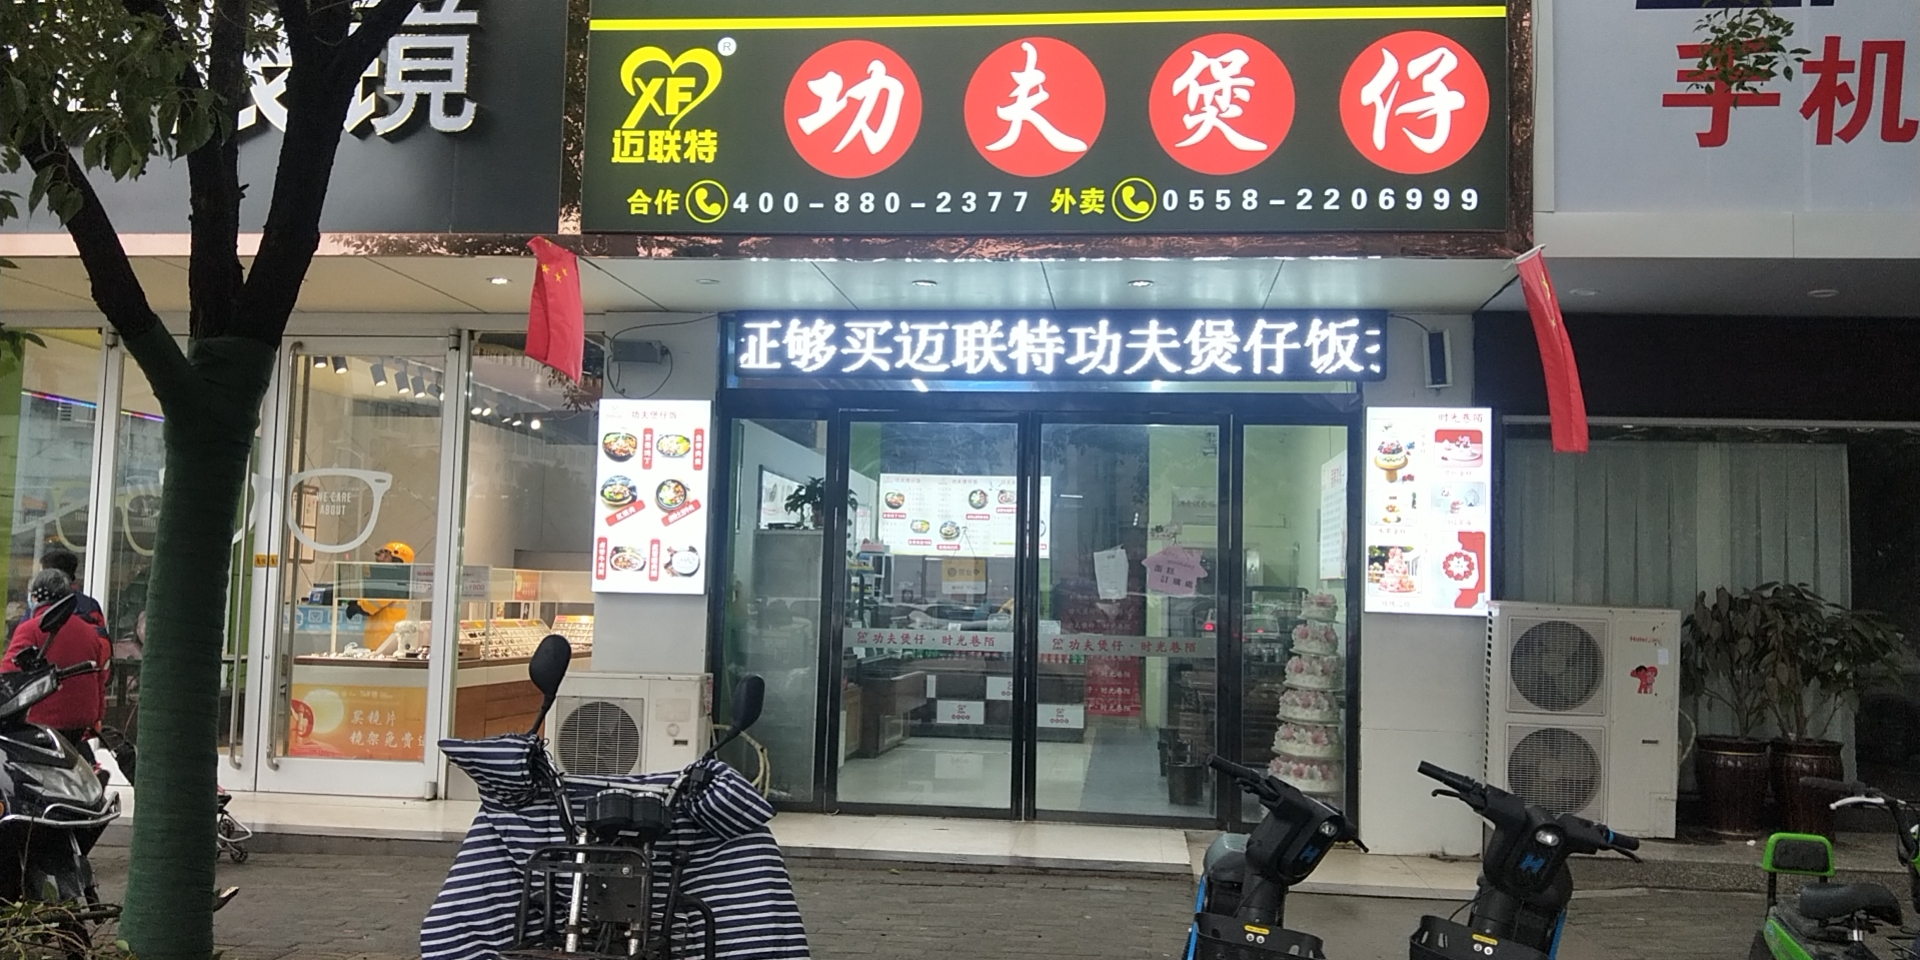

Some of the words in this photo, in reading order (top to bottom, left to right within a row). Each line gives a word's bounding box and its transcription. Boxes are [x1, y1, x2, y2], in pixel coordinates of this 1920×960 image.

[798, 42, 1466, 155] 功夫煲仔
[1662, 36, 1919, 148] 手机
[611, 130, 718, 164] 迈联特
[626, 189, 681, 215] 合作
[733, 191, 1029, 214] 400-880-2377
[1050, 187, 1106, 215] 外卖
[1162, 188, 1480, 212] 0558-2206999
[319, 504, 347, 516] ABOUT
